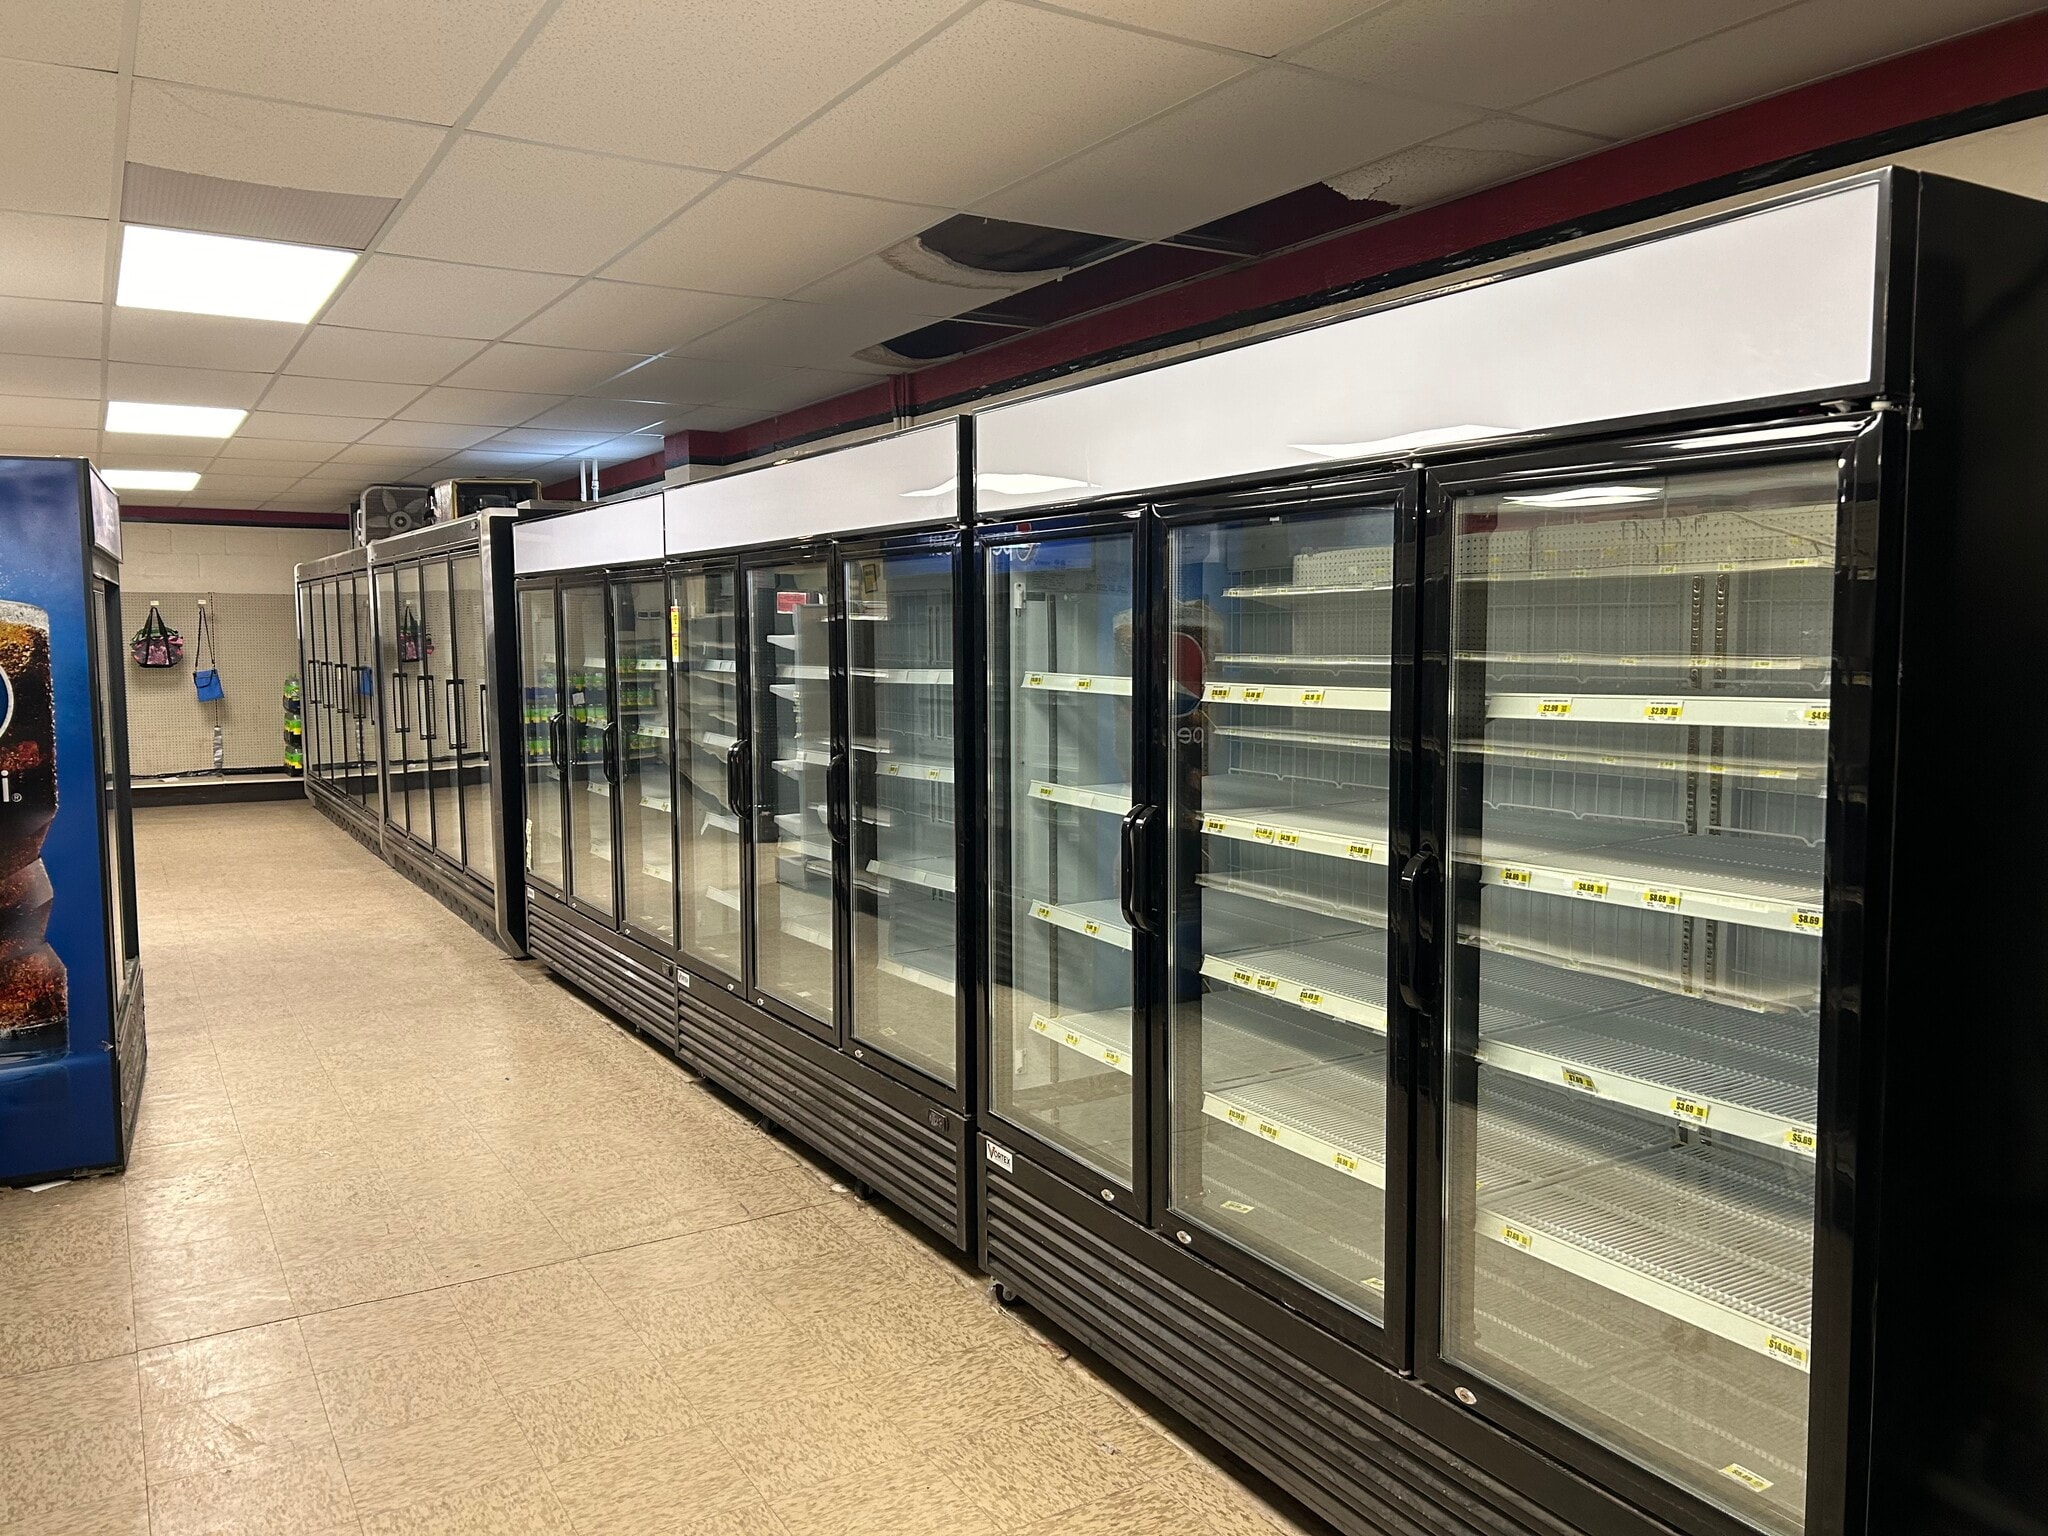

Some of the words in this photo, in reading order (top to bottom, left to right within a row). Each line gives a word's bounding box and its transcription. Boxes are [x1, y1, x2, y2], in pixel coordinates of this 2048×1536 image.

[1543, 704, 1558, 712] $2.99
[1650, 706, 1668, 716] $2.99
[1578, 882, 1594, 892] $8.69
[1649, 893, 1667, 903] $8.69
[1798, 914, 1820, 926] $8.69
[1676, 1101, 1694, 1114] $3.69
[1792, 1132, 1813, 1146] $5.69
[987, 1143, 1011, 1165] VORTEX
[1768, 1339, 1793, 1356] $14.99
